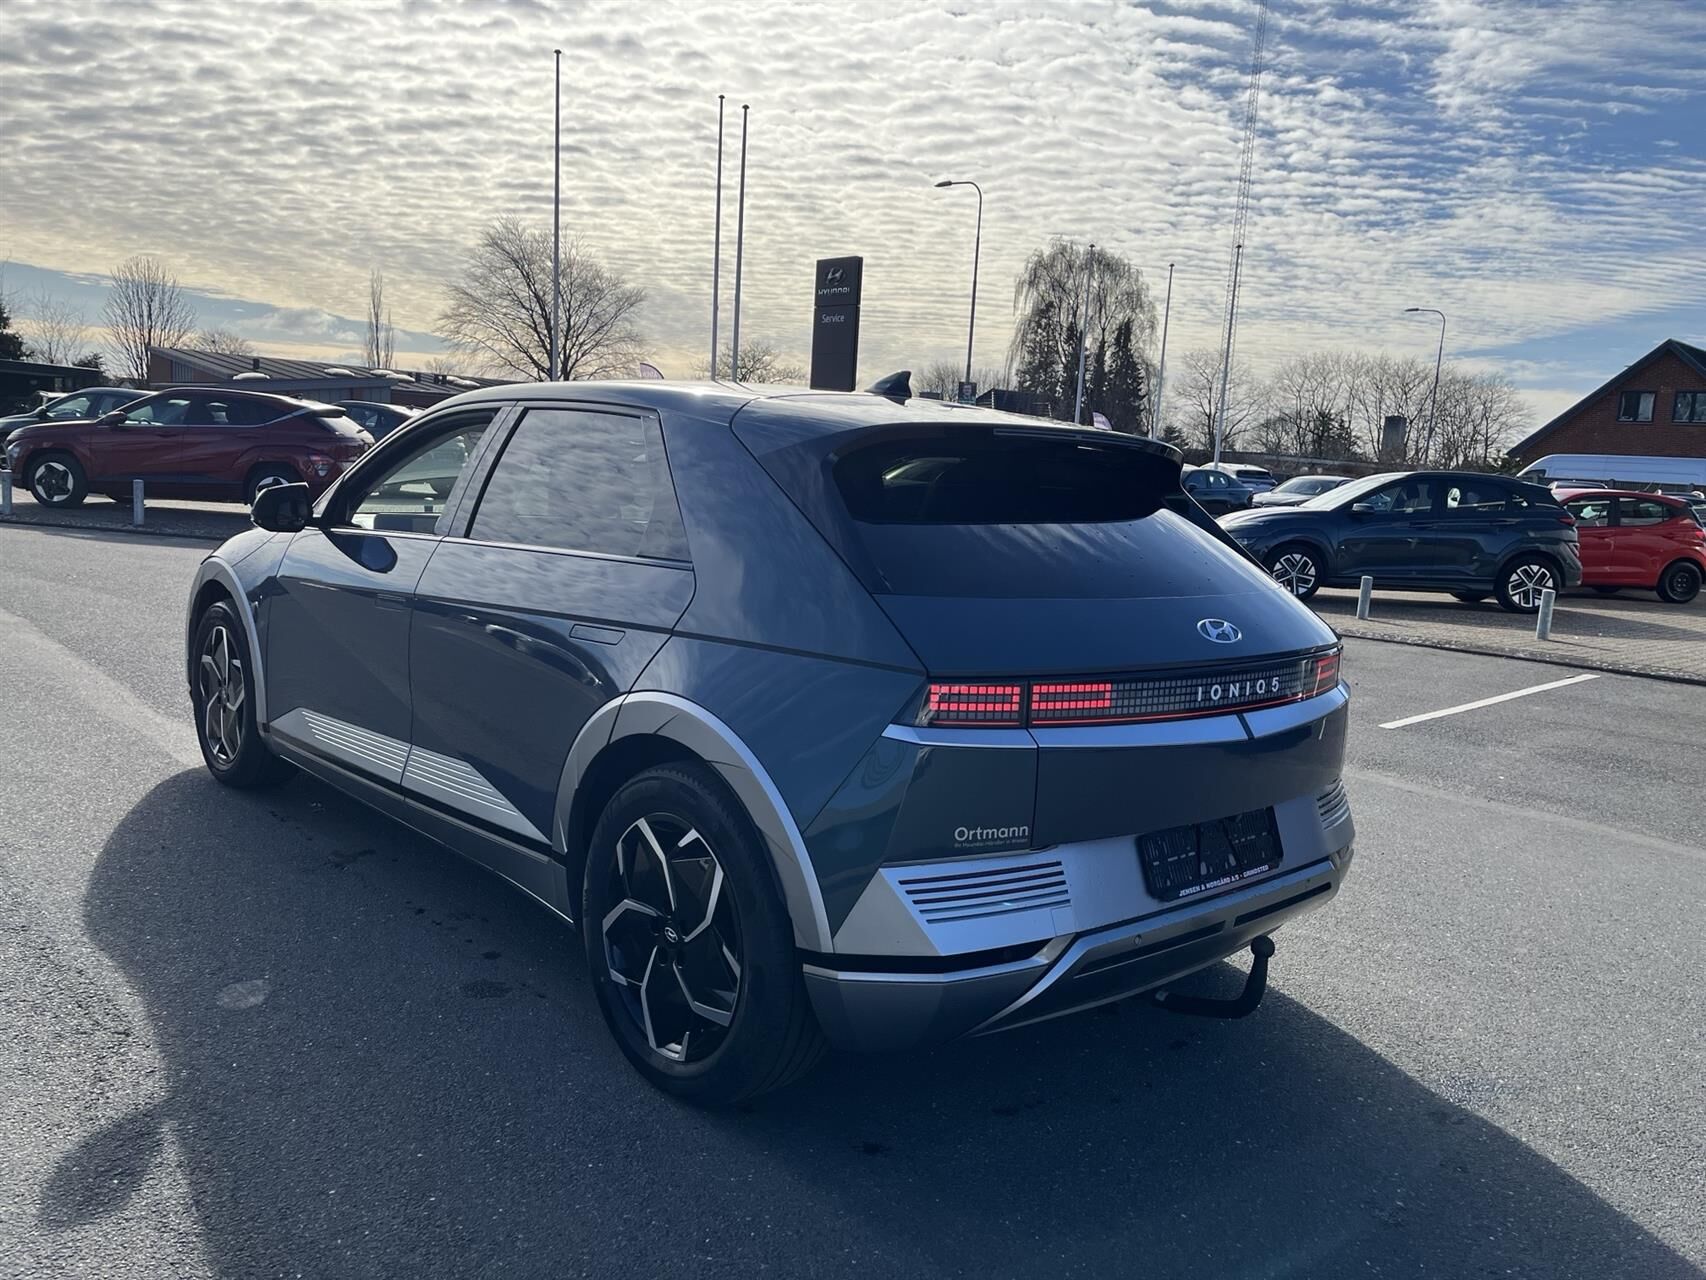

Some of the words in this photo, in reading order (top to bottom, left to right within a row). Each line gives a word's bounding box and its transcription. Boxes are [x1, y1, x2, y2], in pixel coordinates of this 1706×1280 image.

[818, 286, 850, 295] HYUNDAI
[821, 313, 845, 324] Service
[954, 826, 1029, 841] Ortmann
[1179, 885, 1201, 897] JENSEN
